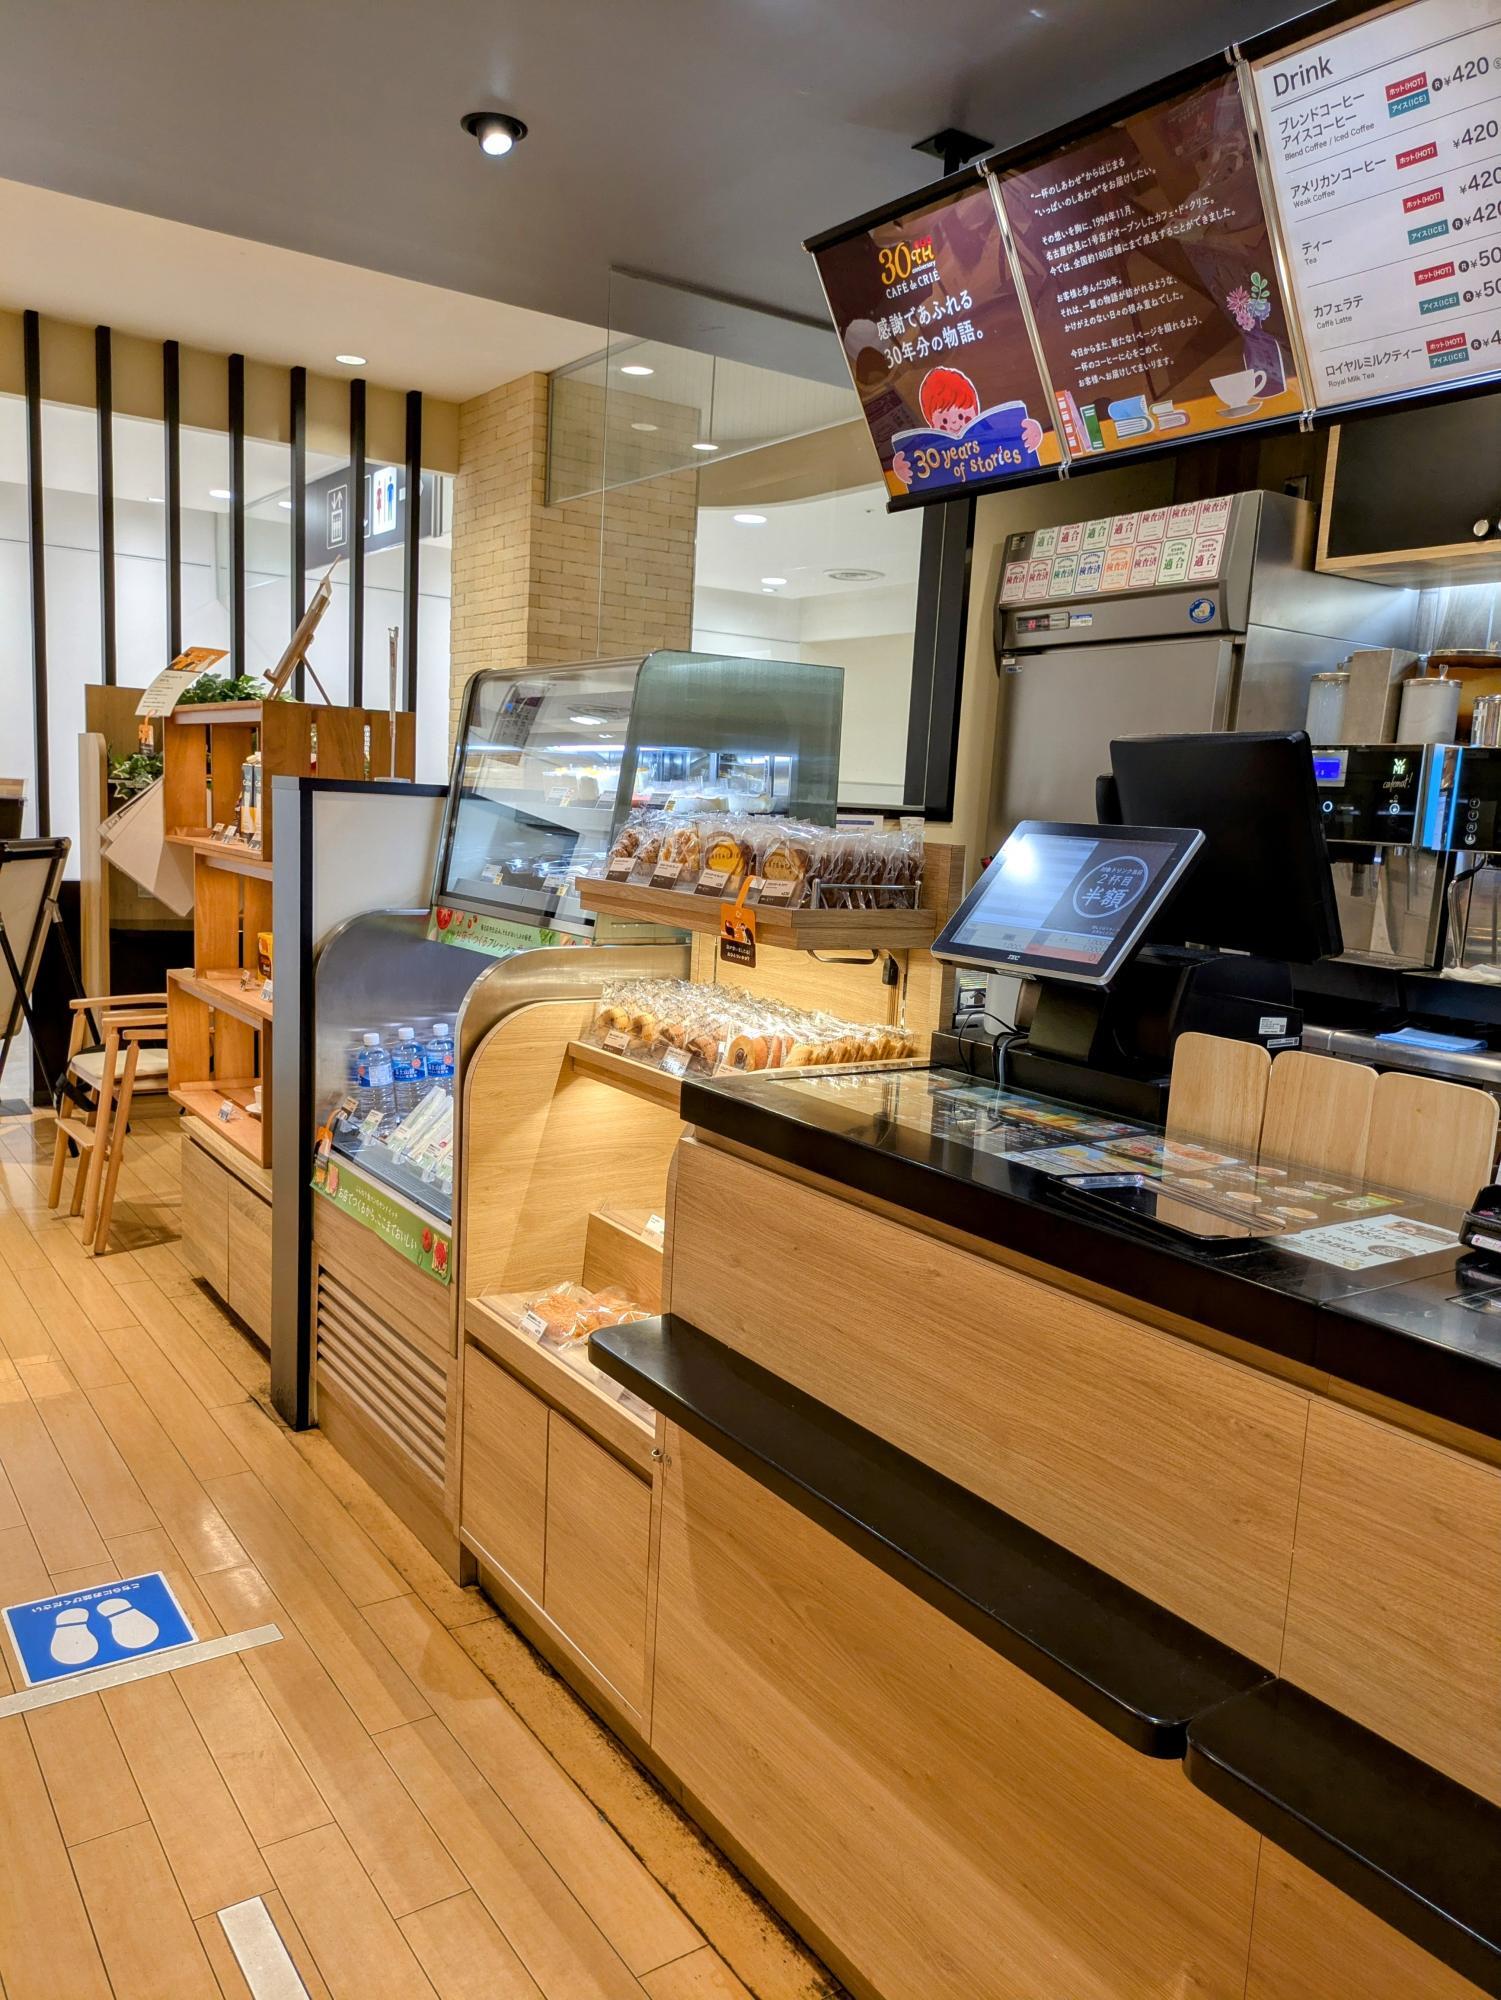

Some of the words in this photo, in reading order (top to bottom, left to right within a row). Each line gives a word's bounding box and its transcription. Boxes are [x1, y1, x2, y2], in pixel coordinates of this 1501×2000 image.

[1273, 56, 1334, 96] Drink
[1444, 57, 1488, 86] ¥420
[1389, 77, 1424, 96] ホット(HOT)
[1279, 93, 1364, 133] ブレンドコーヒー
[1392, 94, 1427, 113] アイス(ICE)
[1282, 115, 1356, 150] アイスコーヒー
[1285, 148, 1304, 160] Blend
[1305, 139, 1328, 154] Coffee
[1334, 131, 1348, 143] Iced
[1350, 122, 1374, 138] Coffee
[1453, 120, 1498, 148] ¥420
[1400, 148, 1434, 164] ホット(HOT)
[1290, 159, 1386, 199] アメリカンコーヒー
[1293, 197, 1312, 209] Weak
[1313, 190, 1336, 204] Coffee
[1406, 192, 1440, 208] ホット(HOT)
[1412, 225, 1446, 240] アイス(ICE)
[1302, 239, 1332, 255] ティー
[1304, 256, 1318, 265] Tea
[886, 281, 910, 299] CAFÉ
[910, 280, 918, 290] de
[918, 270, 940, 287] CRIÉ
[1418, 267, 1452, 281] ホット(HOT)
[877, 290, 972, 341] 感謝であふれる
[1064, 291, 1184, 332] かけがえのない日々の積み重ねでした。
[1314, 295, 1364, 318] カフェラテ
[1422, 298, 1457, 311] アイス(ICE)
[1336, 316, 1352, 326] Latte
[884, 320, 984, 369] 30年分の物語。
[1430, 336, 1464, 350] ホット(HOT)
[1074, 344, 1162, 372] 一杯のコーヒーに心をこめて、
[1326, 348, 1422, 376] ロイヤルミルクティー
[1432, 352, 1466, 364] アイス(ICE)
[1078, 357, 1175, 388] お客様へお届けしてまいります。
[1328, 378, 1347, 388] Royal
[1348, 375, 1361, 384] Milk
[1362, 372, 1374, 380] Tea
[914, 448, 940, 479] 30
[942, 440, 980, 466] years
[954, 464, 966, 482] of
[970, 446, 1022, 473] stories
[1163, 556, 1184, 570] 適合
[1194, 553, 1216, 567] 適合
[1097, 874, 1133, 886] 2杯目
[1082, 886, 1130, 908] 半額
[32, 1583, 140, 1613] こちらにお並びください
